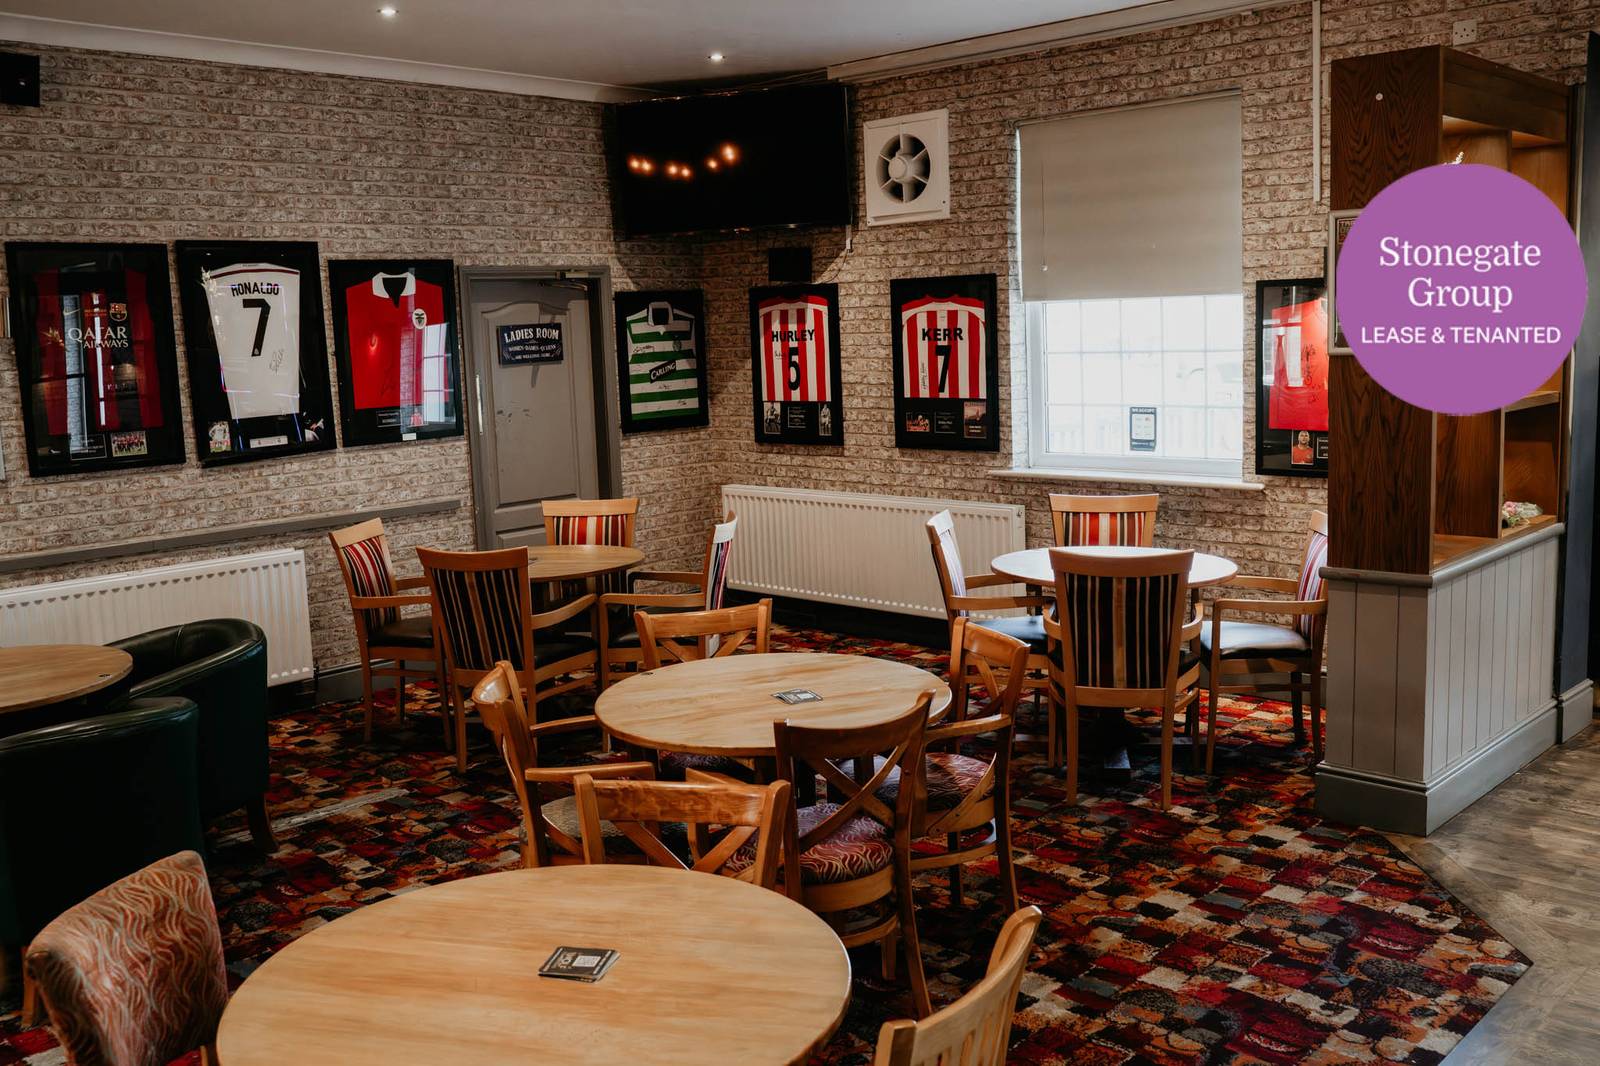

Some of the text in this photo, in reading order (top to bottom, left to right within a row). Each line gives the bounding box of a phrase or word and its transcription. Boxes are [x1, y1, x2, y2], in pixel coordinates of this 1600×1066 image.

[231, 281, 280, 297] RONALDO
[242, 298, 271, 357] 7
[504, 327, 560, 343] LADIES ROOM
[772, 329, 814, 342] HURLEY
[921, 327, 964, 342] KERR
[788, 346, 801, 391] 5
[935, 345, 952, 393] 7
